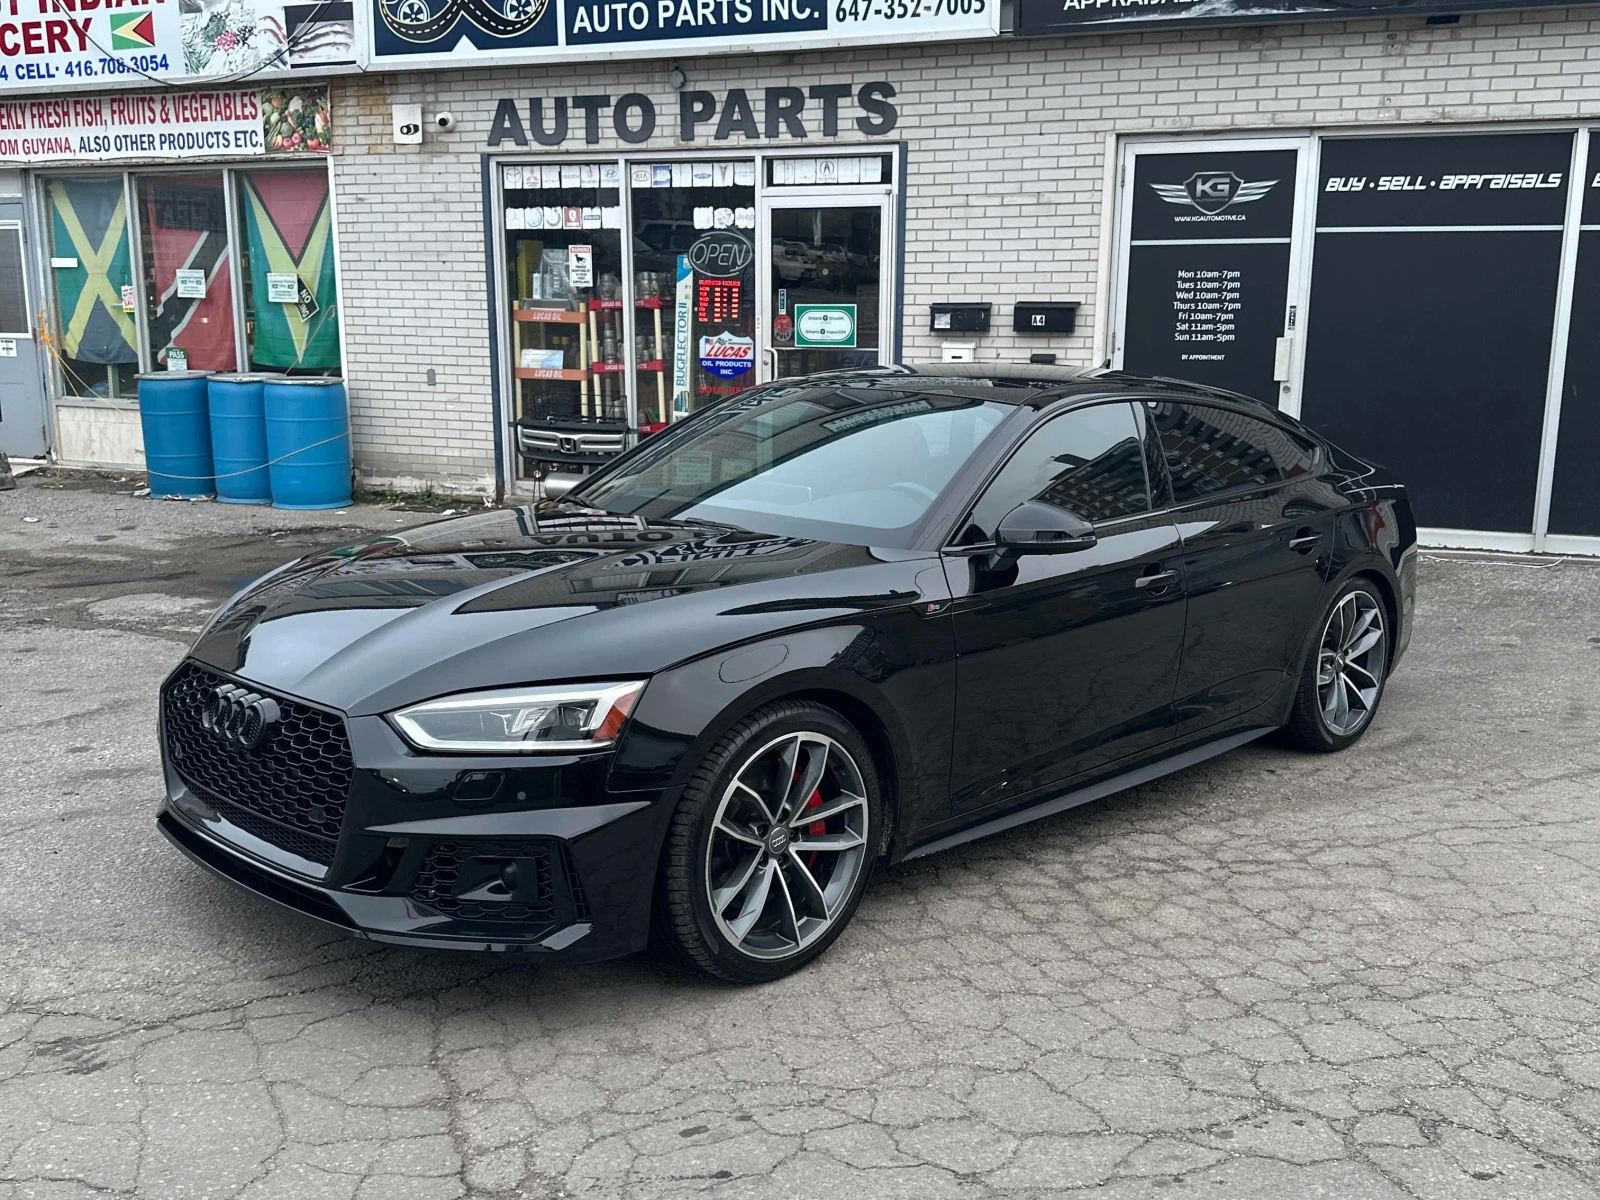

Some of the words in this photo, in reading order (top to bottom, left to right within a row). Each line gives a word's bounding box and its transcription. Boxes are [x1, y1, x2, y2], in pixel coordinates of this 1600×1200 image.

[572, 2, 649, 34] AUTO
[658, 0, 751, 28] PARTS
[762, 0, 820, 22] INC.
[65, 54, 170, 77] 416.708.3054
[30, 100, 71, 129] FRESH
[73, 98, 108, 132] FISH,
[110, 96, 157, 126] FRUITS
[160, 95, 171, 124] &
[172, 91, 258, 123] VEGETABLES
[487, 93, 656, 146] AUTO
[680, 81, 898, 142] PARTS
[22, 137, 76, 157] GUYANA,
[79, 135, 111, 153] ALSO
[114, 133, 156, 152] OTHER
[159, 130, 231, 151] PRODUCTS
[234, 129, 263, 148] ETC.
[1196, 177, 1230, 198] KG
[692, 243, 747, 266] OPEN
[1178, 270, 1194, 278] Mon
[1195, 270, 1240, 279] 10am-7pm
[1177, 281, 1194, 289] Tues
[1195, 281, 1240, 289] 10am-7pm
[300, 289, 311, 303] NO
[1176, 291, 1194, 299] Wed
[1195, 291, 1240, 300] 10am-7pm
[1173, 302, 1195, 310] Thurs
[1196, 302, 1241, 311] 10am-7pm
[533, 312, 551, 320] LUCAS
[1178, 312, 1188, 320] Fri
[1189, 312, 1234, 321] 10am-7pm
[1176, 322, 1189, 331] Sat
[1191, 323, 1235, 332] 11am-5pm
[1174, 333, 1189, 341] Sun
[1191, 333, 1235, 342] 11am-5pm
[675, 310, 688, 386] BUGFLECTOR
[705, 346, 751, 358] LUCAS
[169, 350, 185, 359] PASS
[534, 370, 552, 378] LUCAS
[552, 370, 563, 378] OIL
